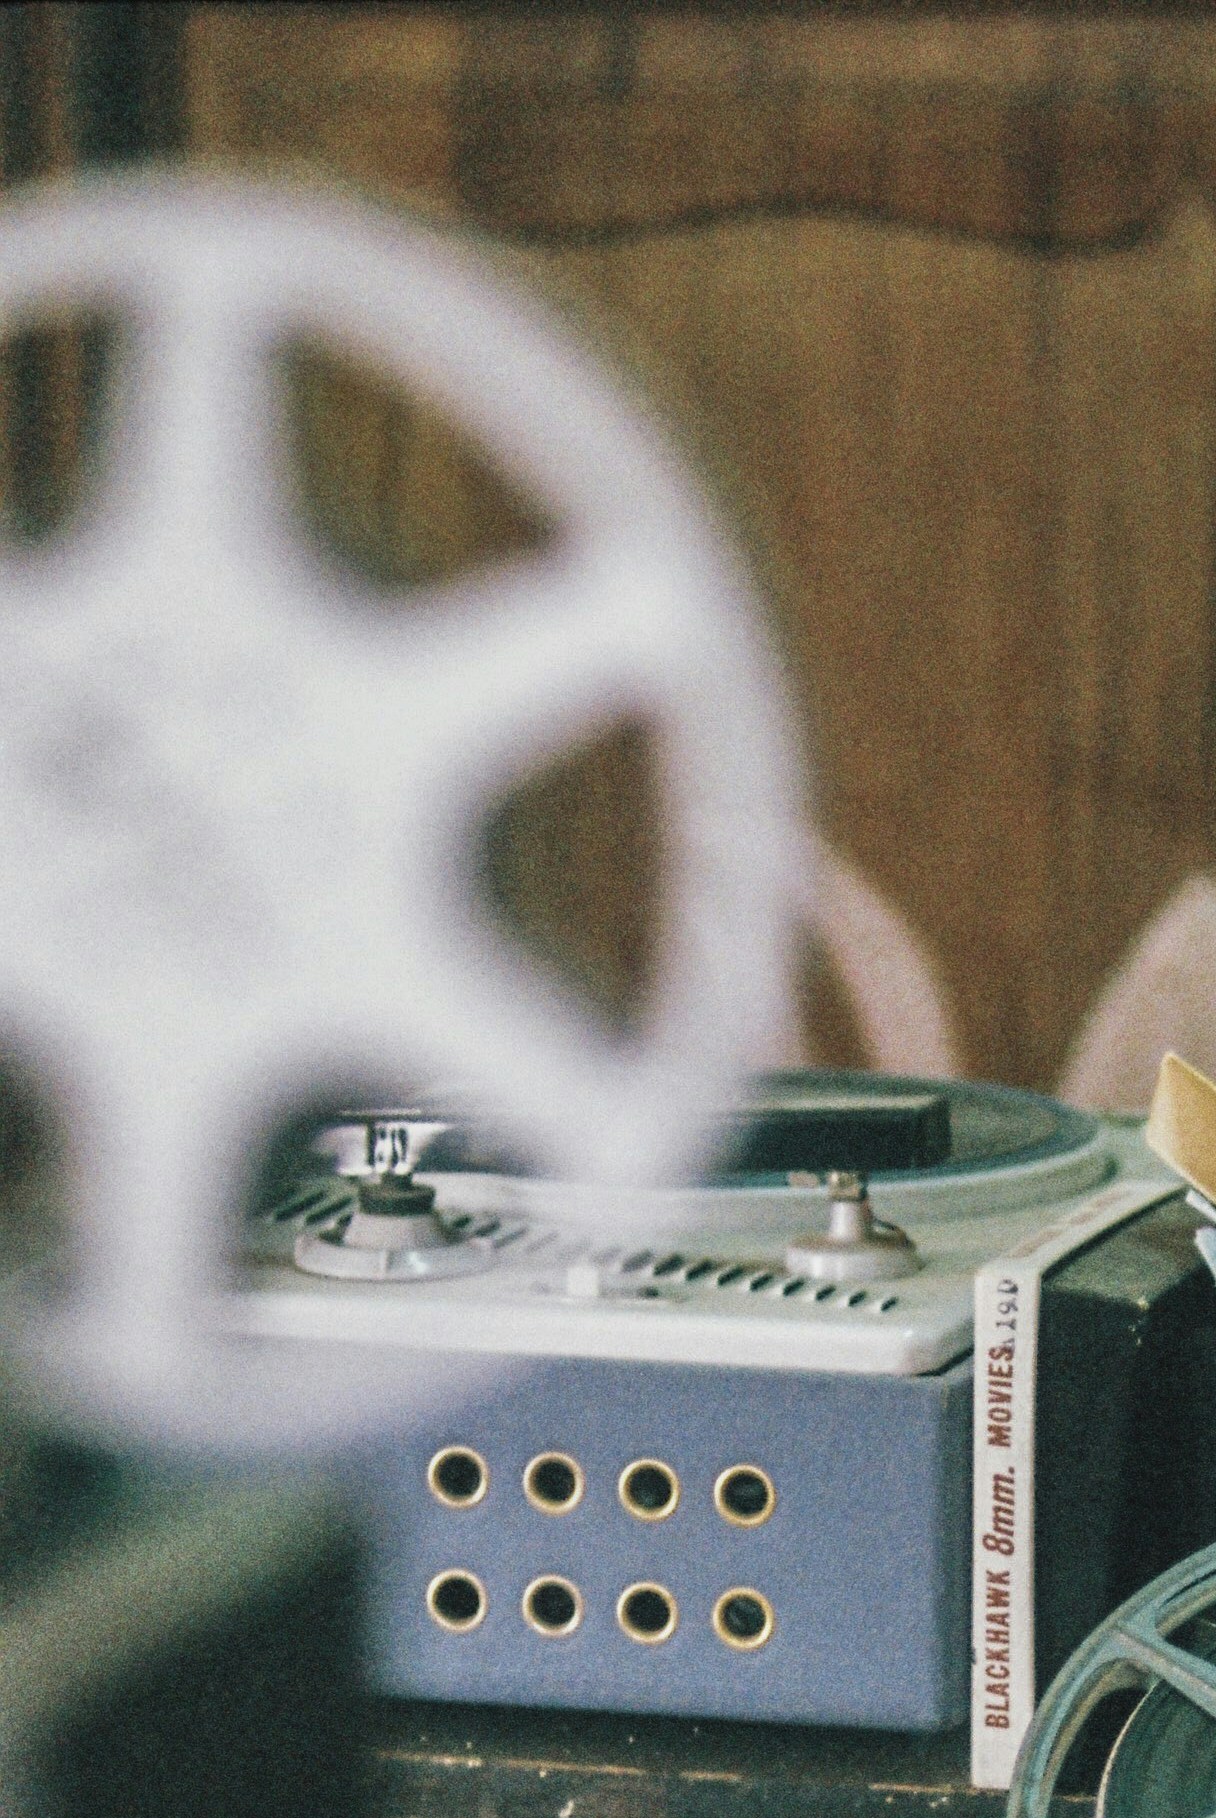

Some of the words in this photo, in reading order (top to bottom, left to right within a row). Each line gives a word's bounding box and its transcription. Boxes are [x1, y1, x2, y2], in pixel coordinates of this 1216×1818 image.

[986, 1346, 1014, 1449] MOVIES
[982, 1465, 1016, 1557] 8mm.
[983, 1568, 1012, 1730] BLACKHAWK
